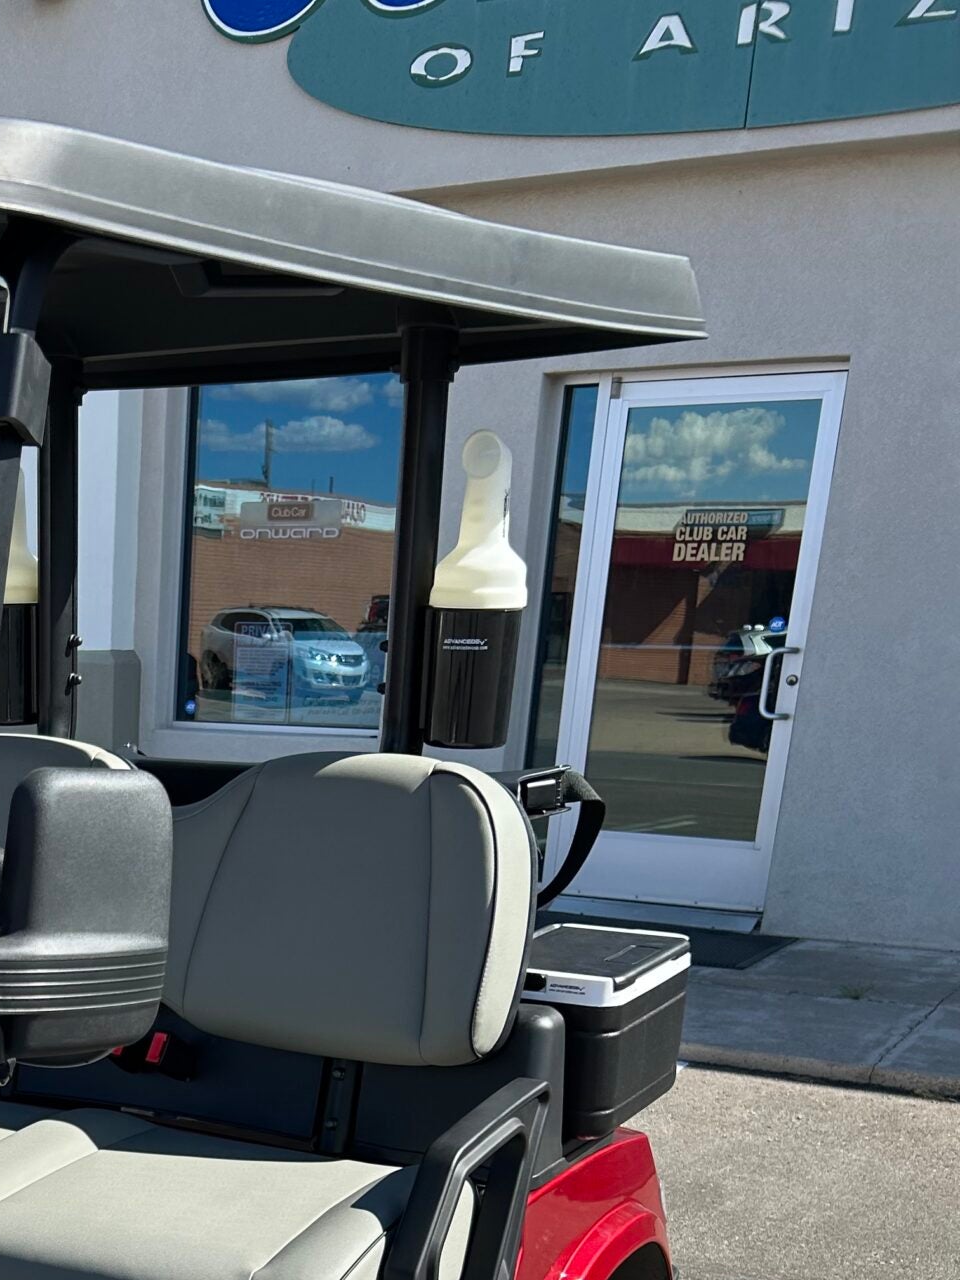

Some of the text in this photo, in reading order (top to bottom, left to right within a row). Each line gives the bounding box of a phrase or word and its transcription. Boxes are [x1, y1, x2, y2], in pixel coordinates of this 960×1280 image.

[410, 31, 543, 80] OF
[681, 512, 748, 524] AUTHORIZED
[676, 526, 748, 540] CLUB CAR
[672, 542, 746, 561] DEALER
